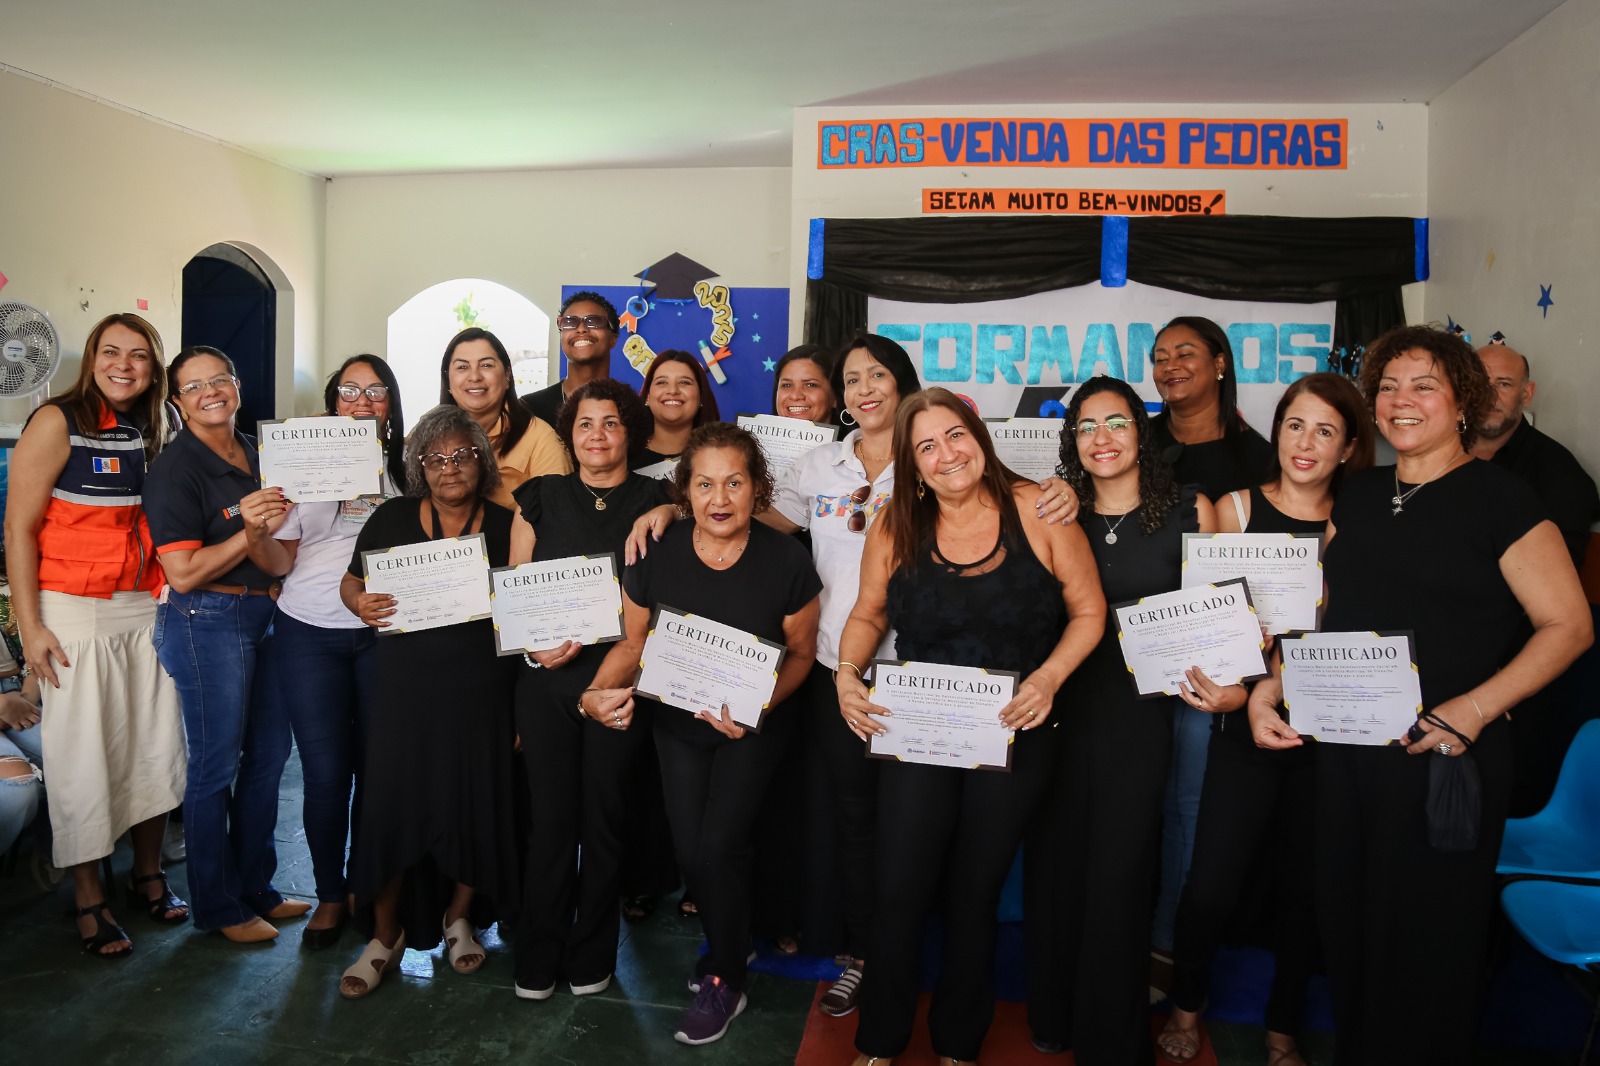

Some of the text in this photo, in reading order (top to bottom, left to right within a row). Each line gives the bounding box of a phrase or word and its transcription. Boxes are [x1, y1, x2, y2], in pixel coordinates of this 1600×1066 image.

[821, 121, 1341, 167] CRAS-VENDA DAS PEDRAS
[1007, 192, 1069, 210] MUITO
[1079, 191, 1224, 215] BEM-VINDOS!
[695, 281, 734, 346] 2025
[876, 322, 1332, 385] ORMANOS
[271, 427, 368, 441] CERTIFICADO
[743, 423, 824, 443] CERTIFICADO
[994, 428, 1061, 440] CERTIFIC
[376, 546, 473, 571] CERTIFICADO
[1197, 546, 1308, 559] CERTIFICADO
[503, 565, 603, 589] CERTIFICADO
[1128, 594, 1236, 626] CERTIFICADO
[666, 621, 768, 663] CERTIFICADO
[1290, 646, 1397, 661] CERTIFICADO
[886, 673, 1001, 696] CERTIFICADO
